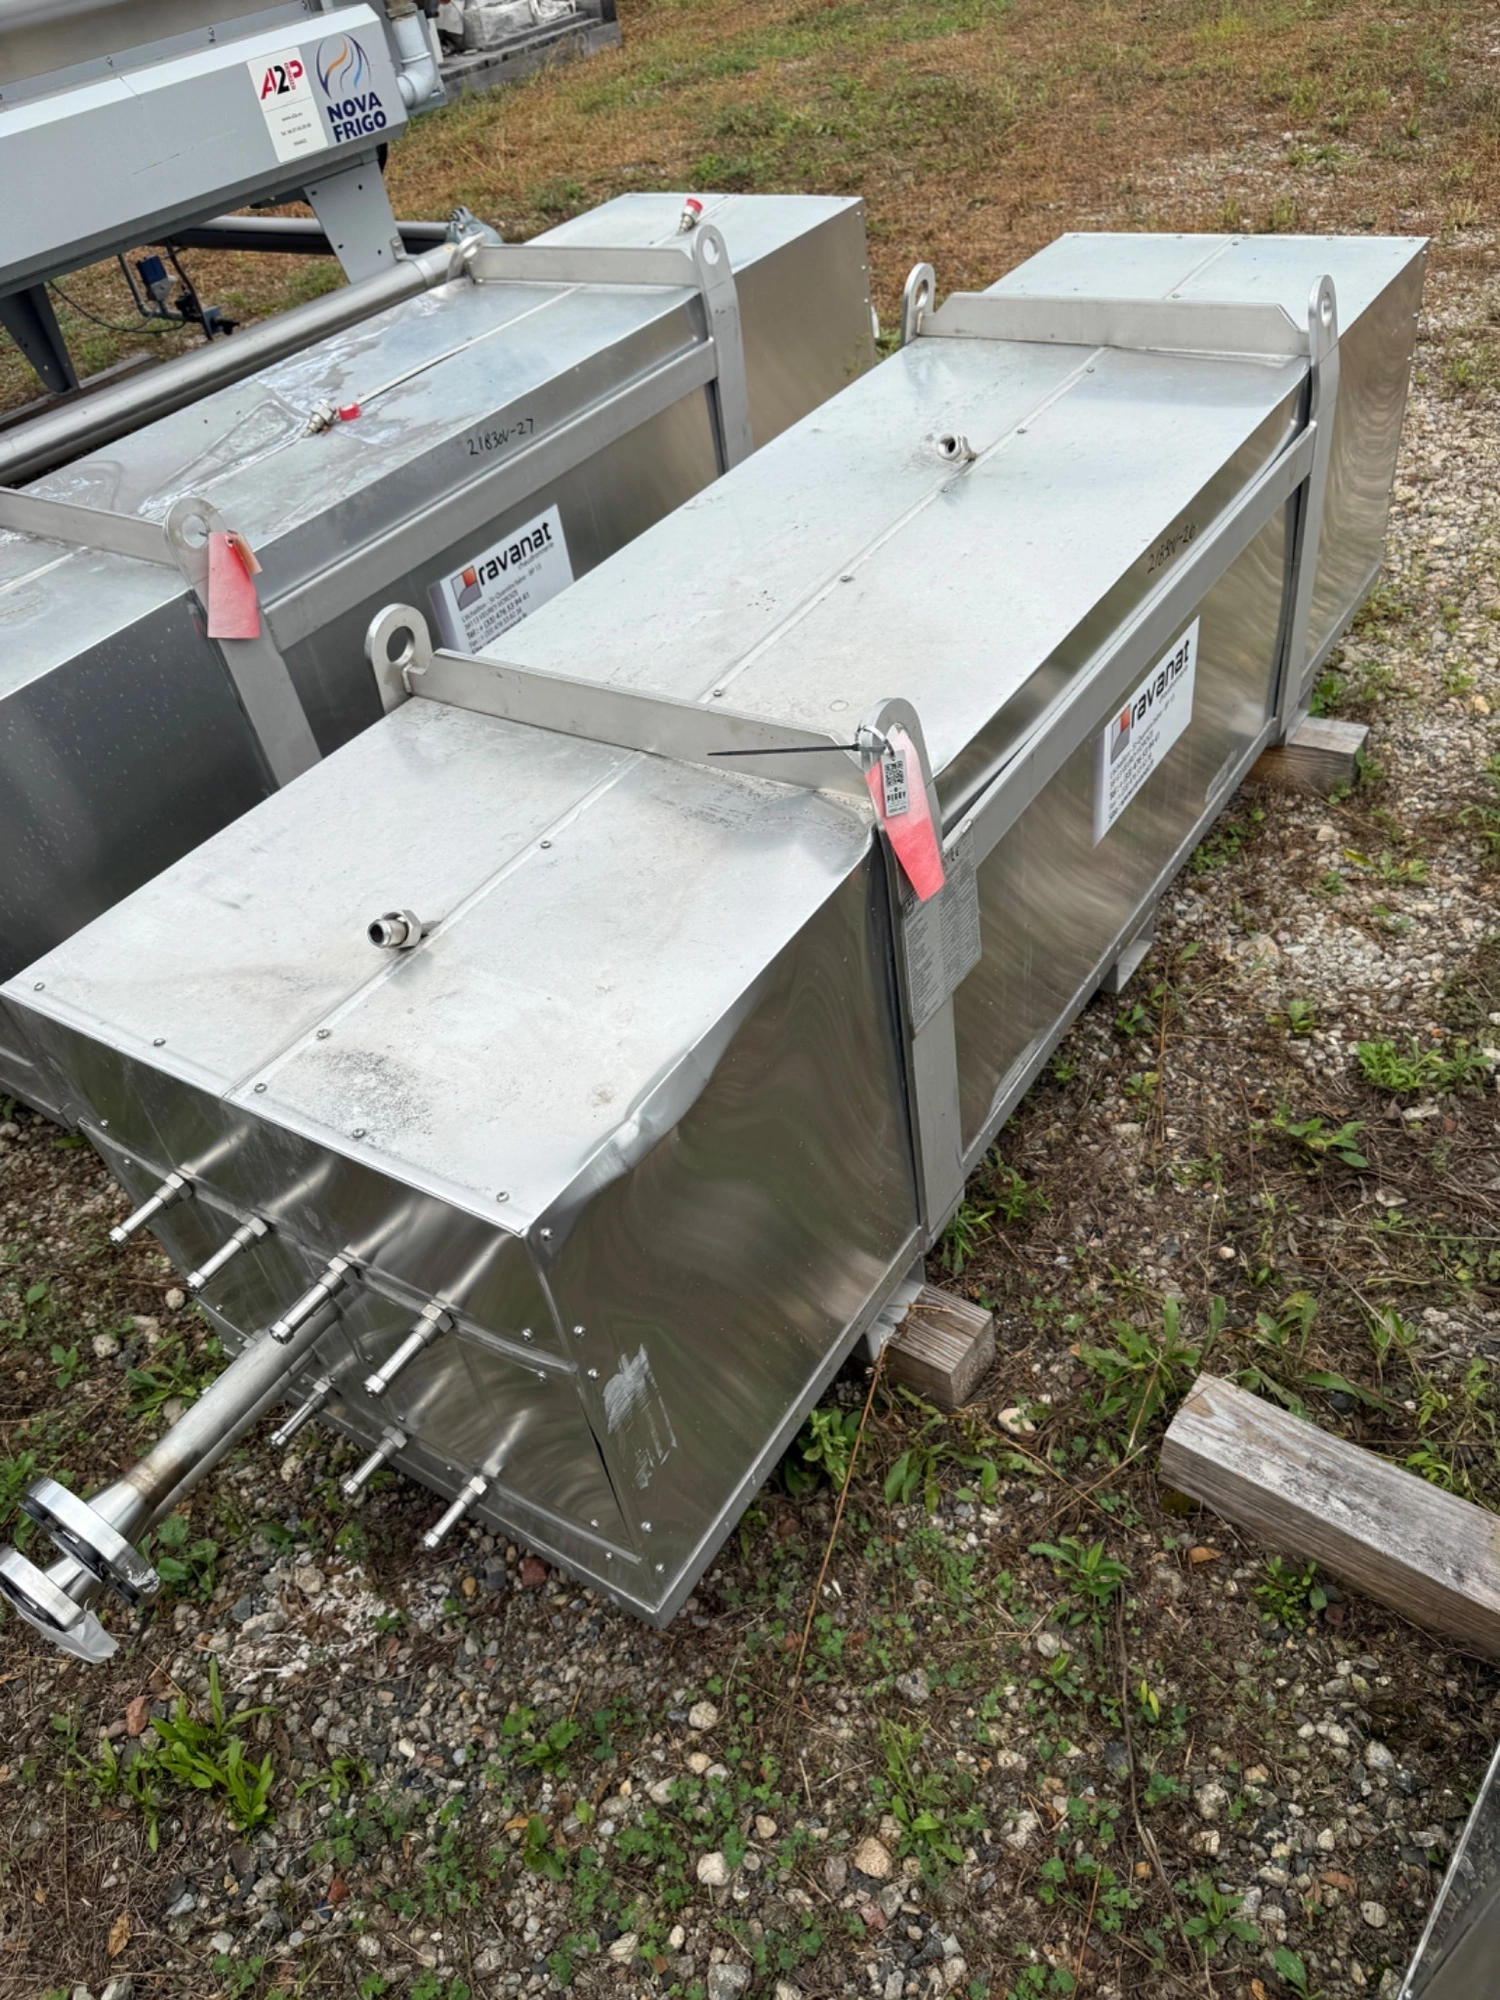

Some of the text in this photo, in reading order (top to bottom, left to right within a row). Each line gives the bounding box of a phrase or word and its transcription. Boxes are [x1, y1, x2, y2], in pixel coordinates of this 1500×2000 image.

[260, 59, 303, 100] A2P
[326, 91, 382, 123] NOVA
[332, 110, 387, 143] FRIGO
[479, 522, 552, 585] ravanat
[1130, 639, 1190, 730] ravanat
